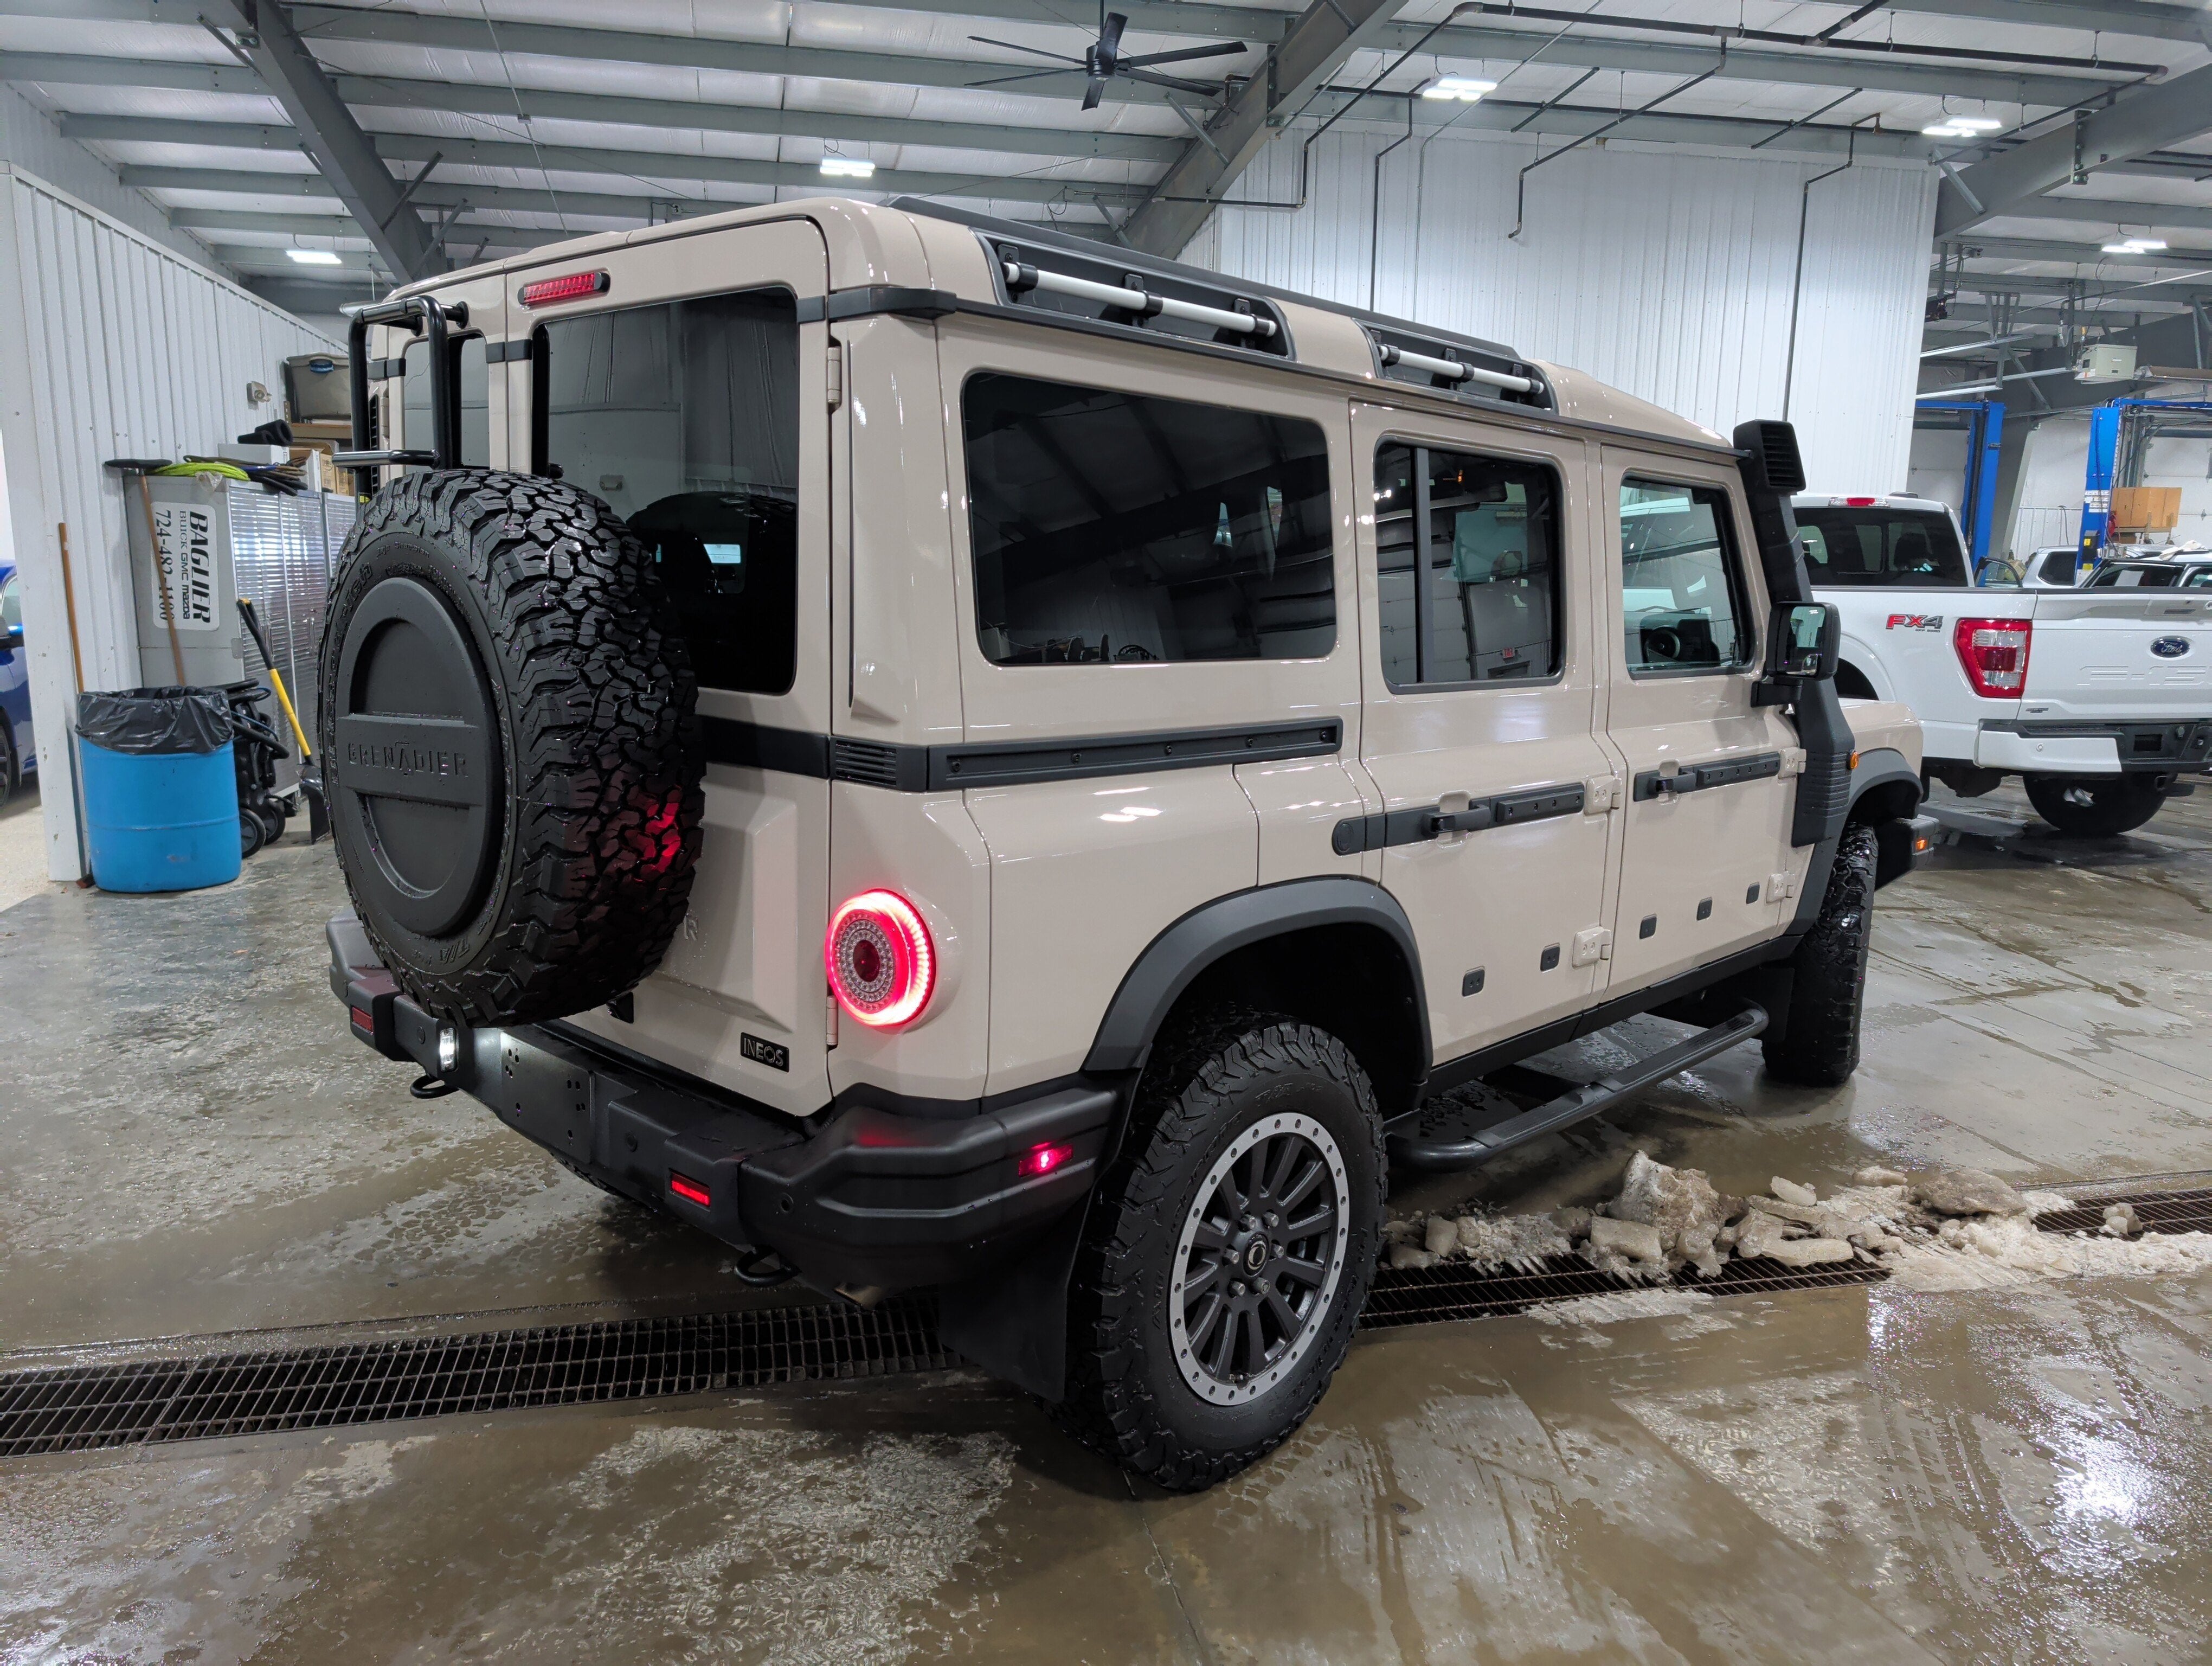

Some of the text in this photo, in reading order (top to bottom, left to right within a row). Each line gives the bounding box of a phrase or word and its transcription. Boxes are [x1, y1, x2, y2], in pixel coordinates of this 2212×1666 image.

[179, 510, 188, 549] BUICK
[181, 552, 189, 581] GMC
[190, 510, 211, 623] BAGLIER
[1886, 613, 1944, 630] FX4
[2161, 642, 2183, 653] Ford
[2077, 666, 2212, 685] F-15
[348, 741, 470, 778] GRENADIER
[743, 1037, 784, 1067] INEOS
